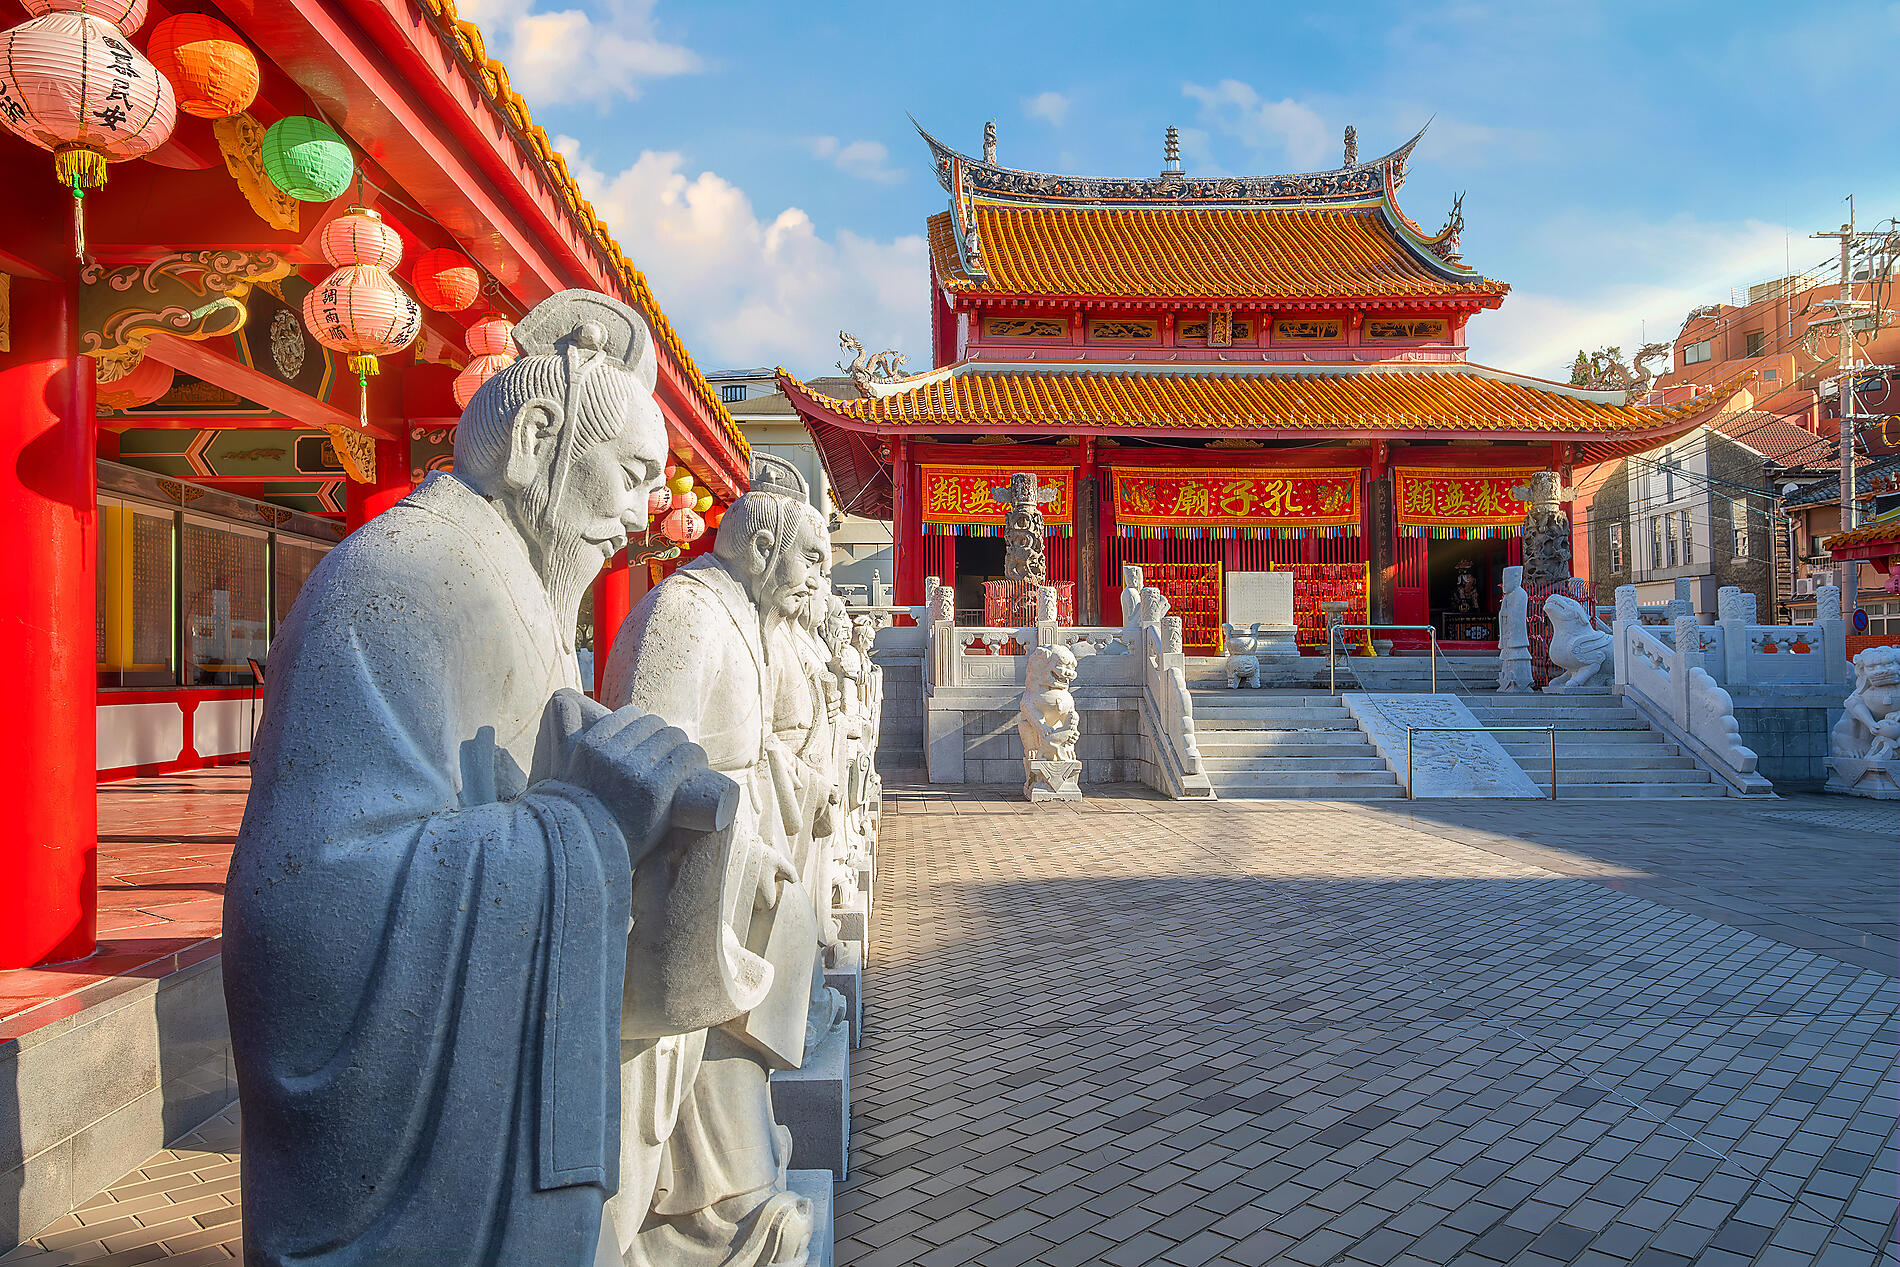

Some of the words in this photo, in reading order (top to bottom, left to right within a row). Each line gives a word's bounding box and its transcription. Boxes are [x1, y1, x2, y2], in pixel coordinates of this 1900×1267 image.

[930, 475, 1066, 515] 有無類
[1170, 479, 1304, 517] 孔子廟
